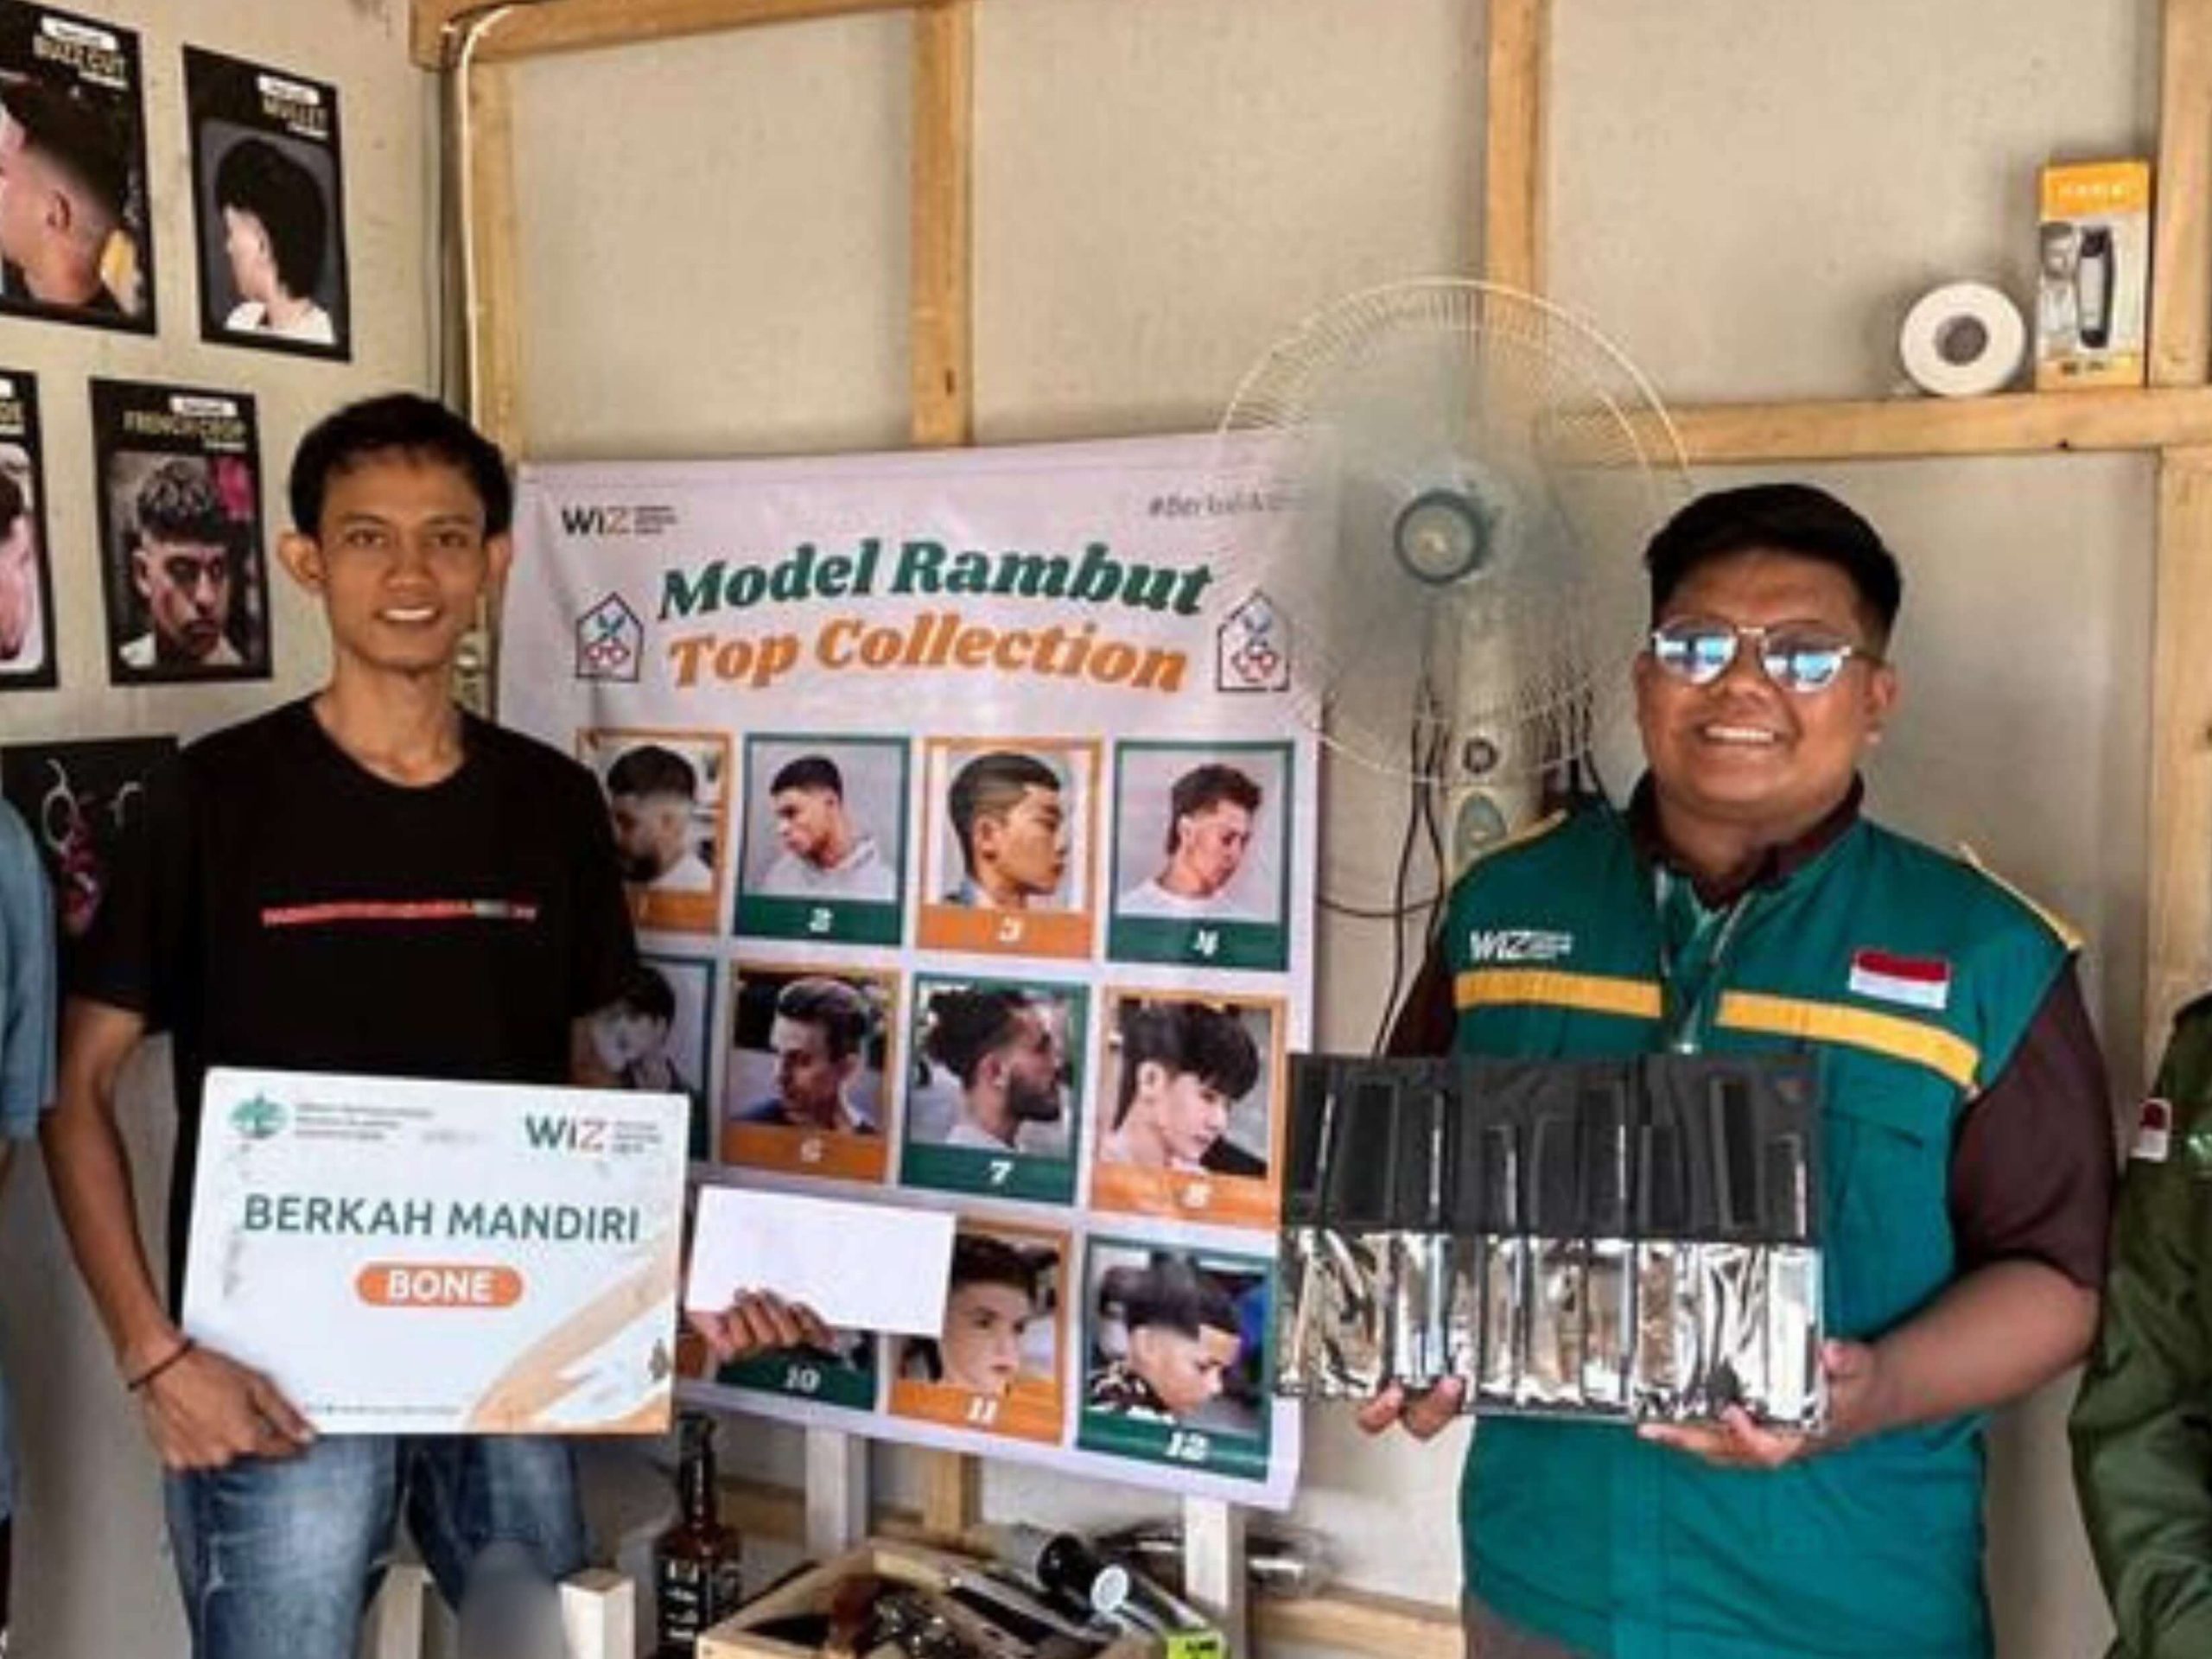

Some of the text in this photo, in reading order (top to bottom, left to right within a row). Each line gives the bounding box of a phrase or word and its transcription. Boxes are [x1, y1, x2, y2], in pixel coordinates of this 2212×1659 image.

[658, 538, 1212, 621] Model Rambut
[669, 608, 1187, 692] Top Collection
[809, 907, 833, 932] 2
[997, 917, 1020, 942] 3
[1194, 929, 1219, 955] 4
[988, 1160, 1014, 1185] 7
[245, 1193, 639, 1243] BERKAH MANDIRI
[388, 1268, 493, 1300] BONE
[785, 1368, 821, 1393] 10
[966, 1398, 999, 1425] 11
[1166, 1431, 1210, 1462] 12
